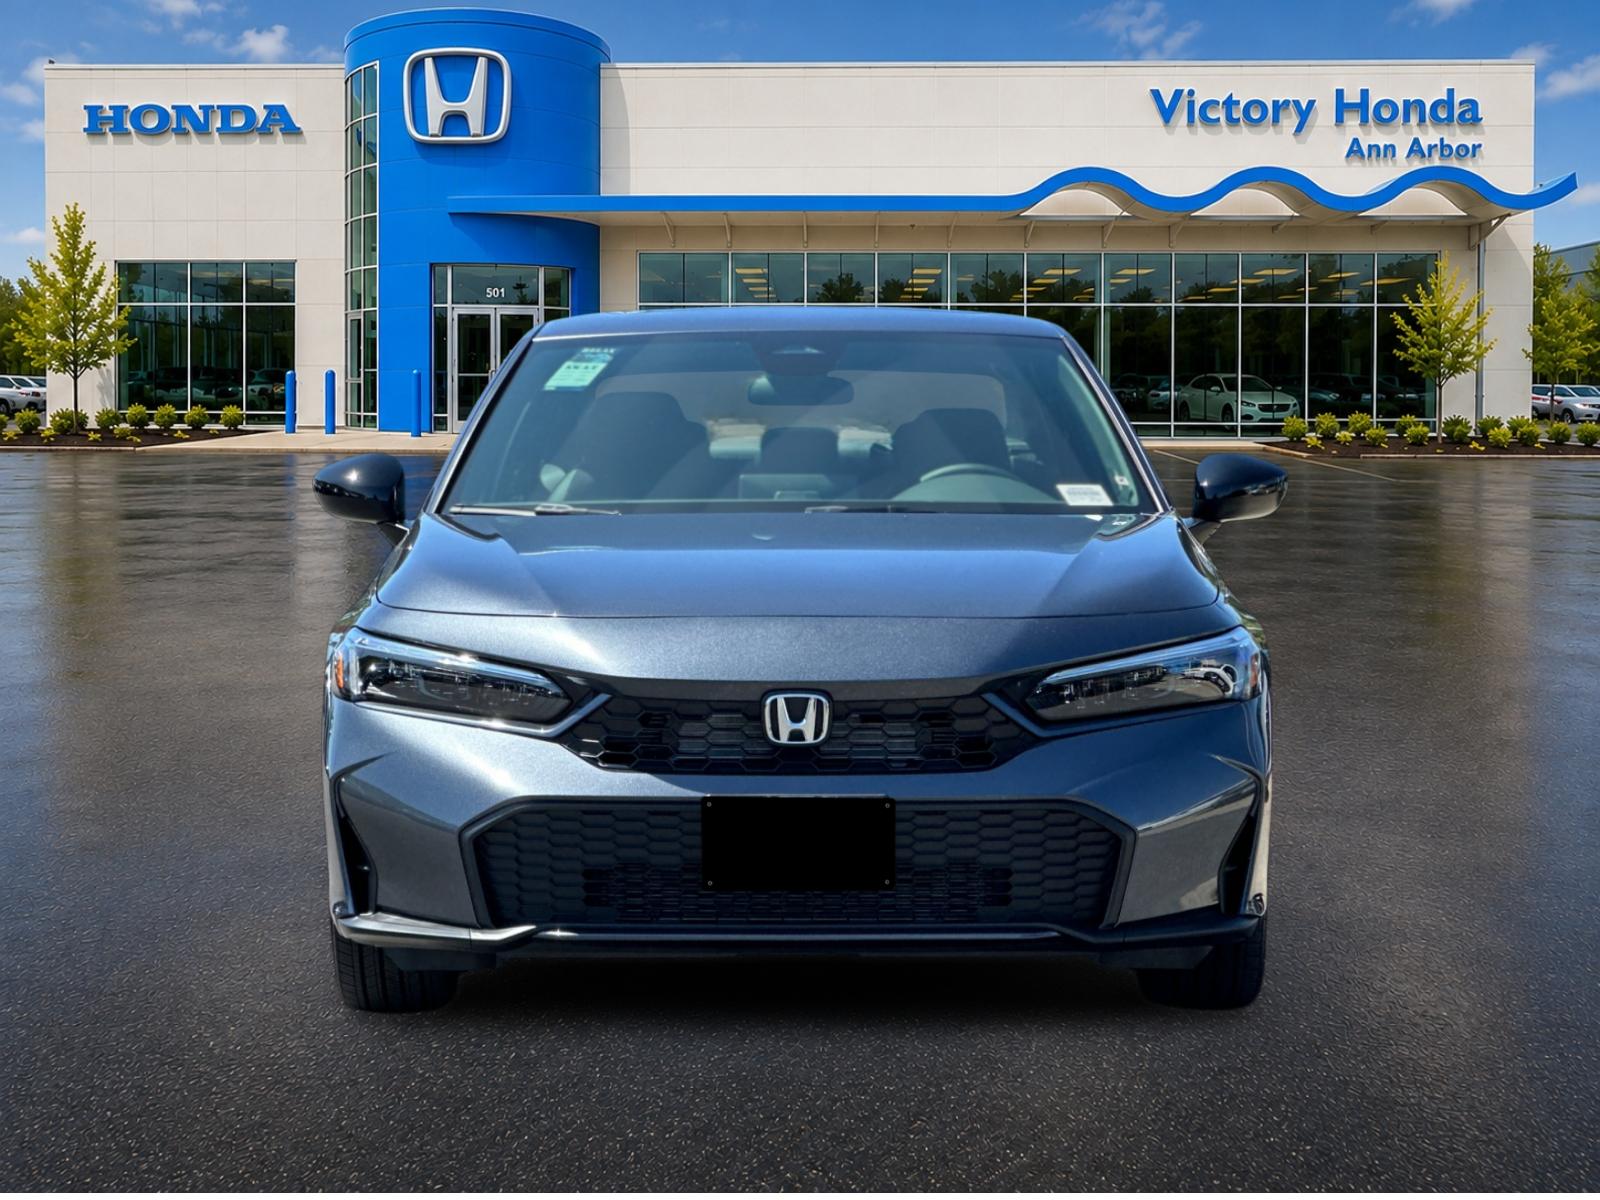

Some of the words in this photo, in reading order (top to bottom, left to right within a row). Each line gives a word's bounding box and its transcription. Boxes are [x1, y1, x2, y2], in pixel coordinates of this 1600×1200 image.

[83, 104, 302, 135] HONDA
[1150, 88, 1316, 134] Victory
[1334, 87, 1483, 126] Honda
[1346, 137, 1397, 160] Ann
[1405, 137, 1483, 160] Arbor
[486, 287, 505, 298] 501
